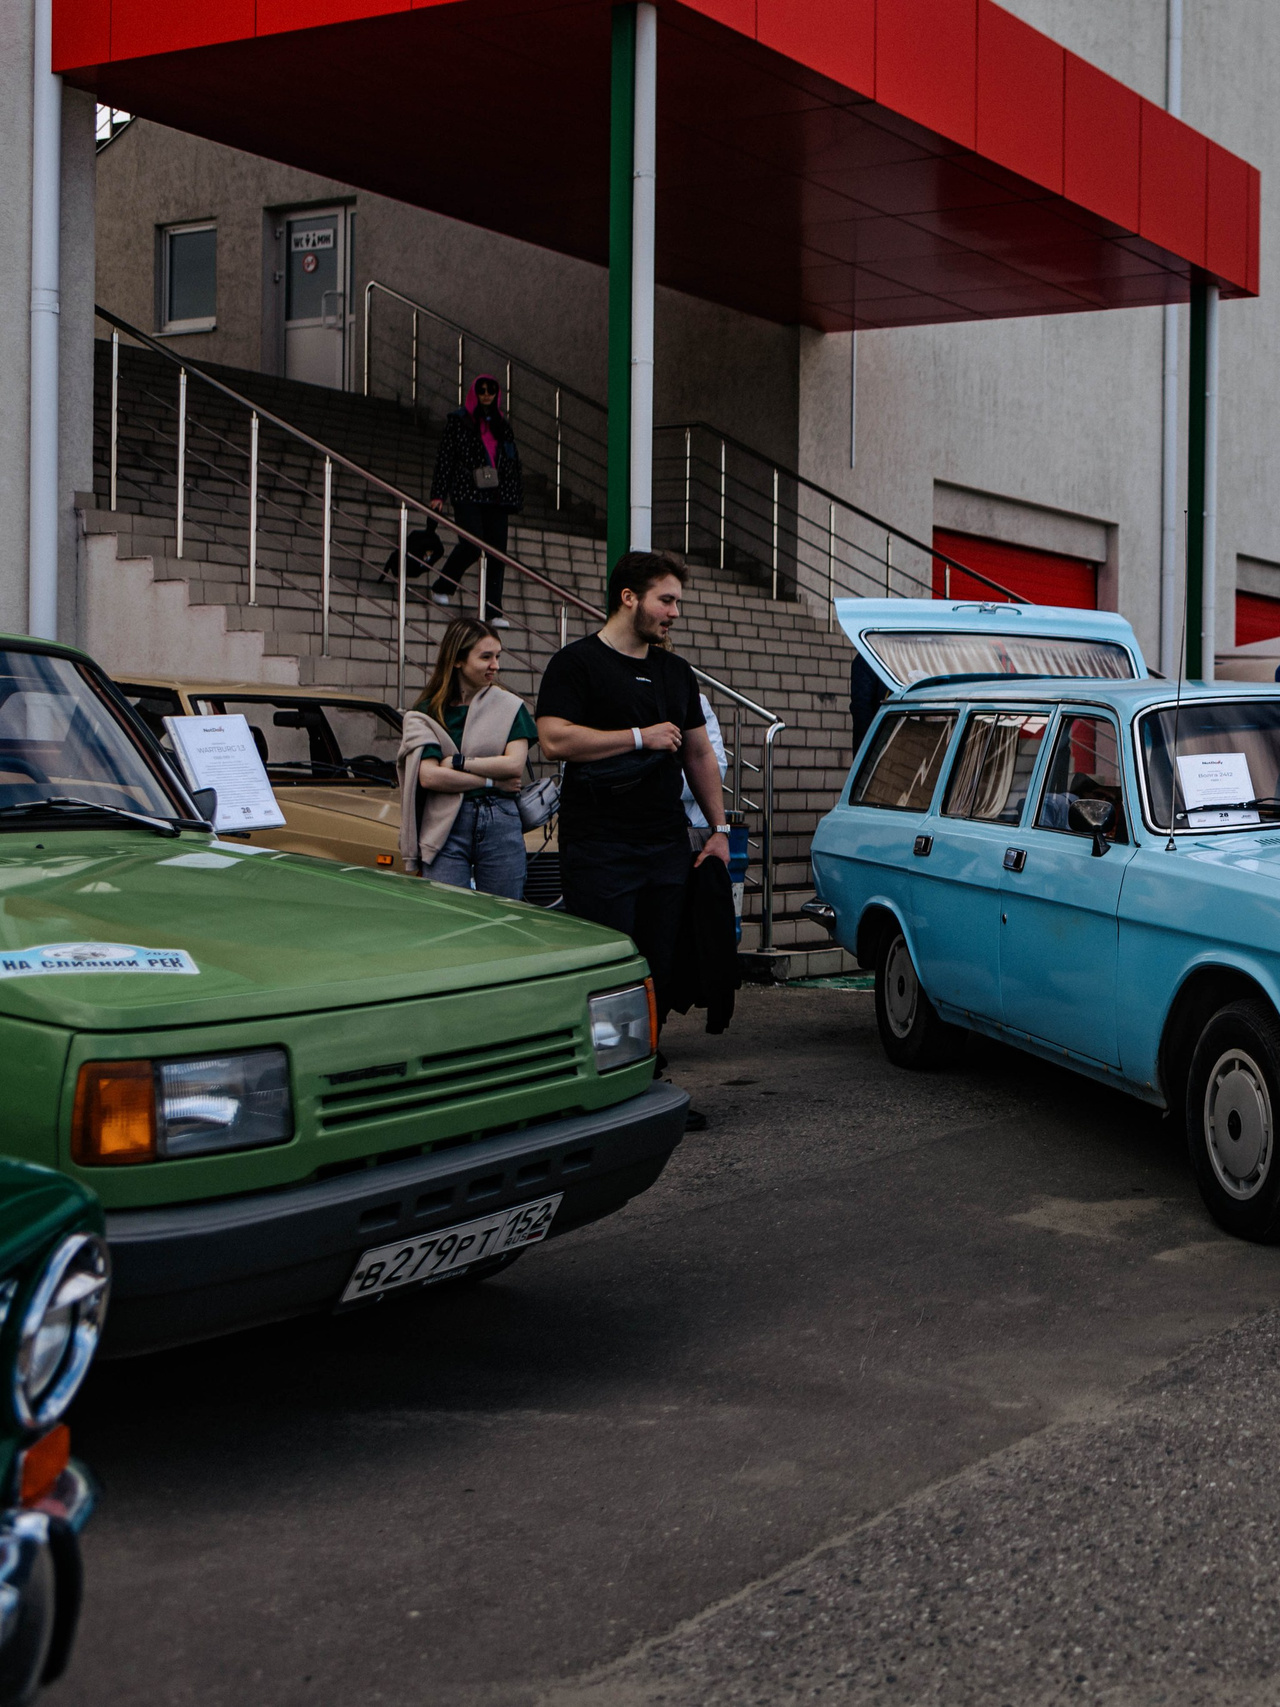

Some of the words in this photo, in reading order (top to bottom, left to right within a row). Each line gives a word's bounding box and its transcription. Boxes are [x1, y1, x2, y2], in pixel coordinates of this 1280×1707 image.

[2, 959, 33, 972] НА
[148, 957, 185, 968] РЕК
[506, 1202, 553, 1238] 152
[503, 1232, 528, 1247] RUS
